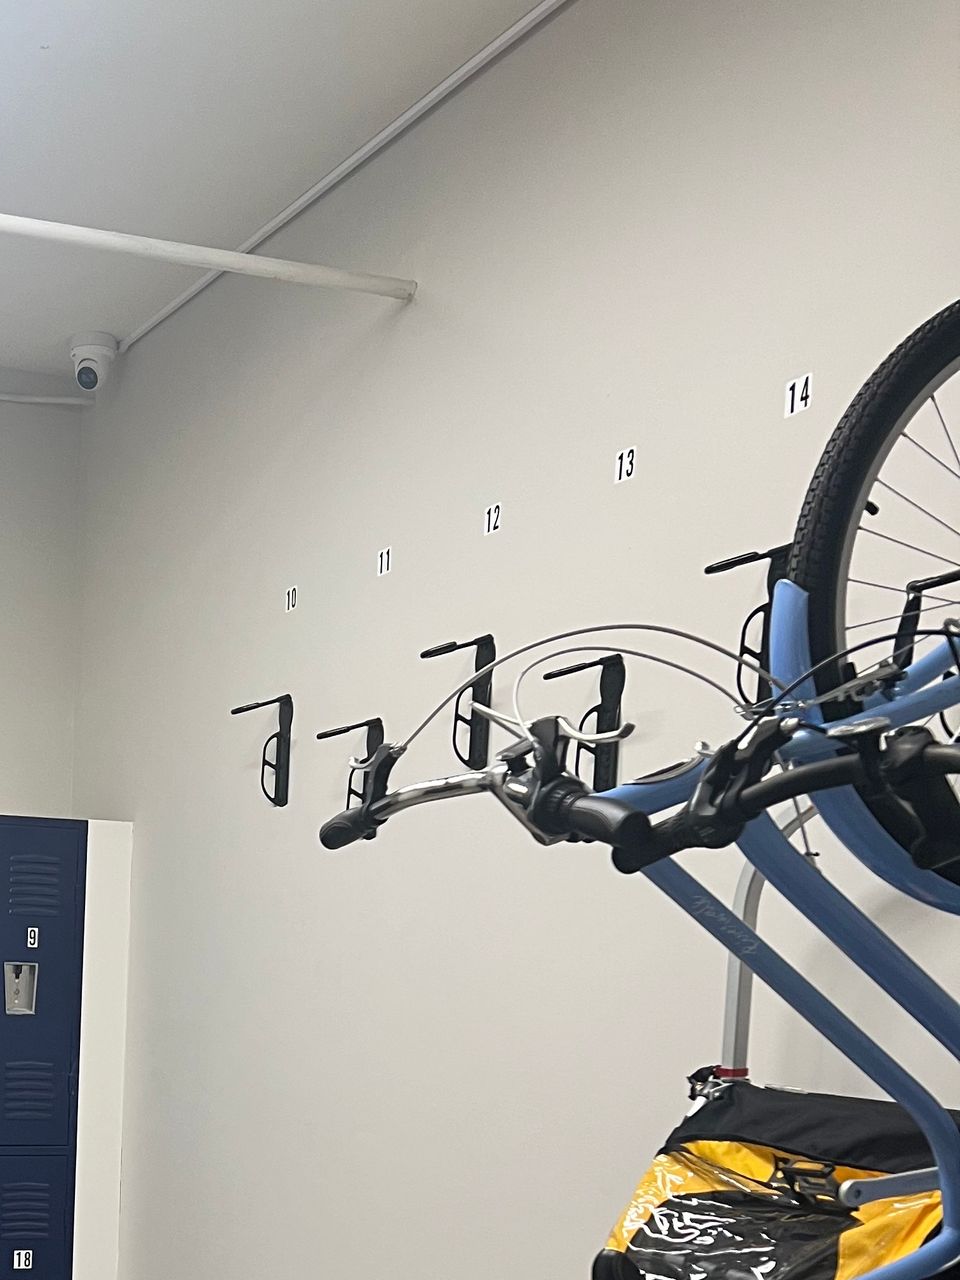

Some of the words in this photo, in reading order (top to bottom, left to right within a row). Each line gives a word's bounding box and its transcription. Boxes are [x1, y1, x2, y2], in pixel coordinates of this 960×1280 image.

[789, 377, 811, 415] 14
[617, 448, 636, 482] 13
[486, 504, 501, 534] 12
[379, 548, 391, 575] 11
[286, 587, 298, 611] 10
[29, 929, 37, 946] 9
[16, 1251, 31, 1268] 18
